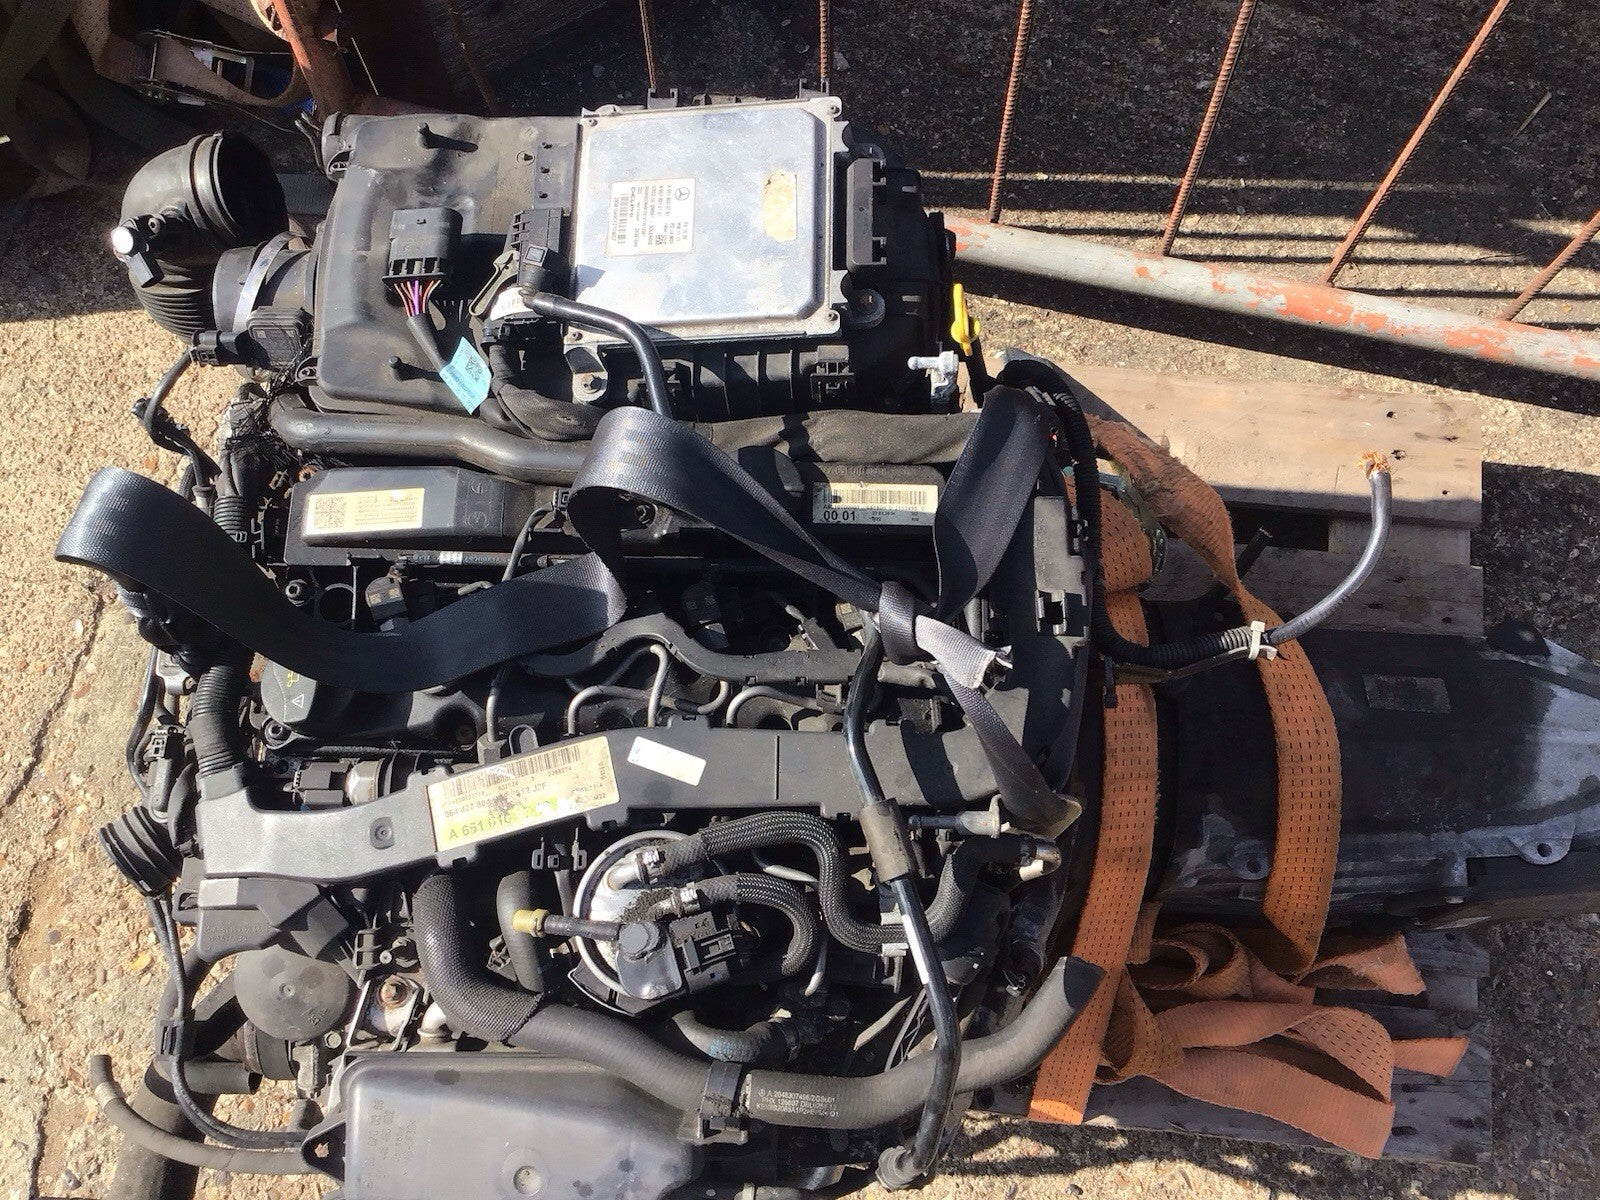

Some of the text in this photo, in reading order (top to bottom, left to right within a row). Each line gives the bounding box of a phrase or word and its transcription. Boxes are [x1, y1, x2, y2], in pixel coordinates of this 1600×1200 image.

[823, 510, 838, 521] 00
[842, 510, 856, 521] 01
[449, 828, 459, 840] A
[461, 820, 484, 837] 651
